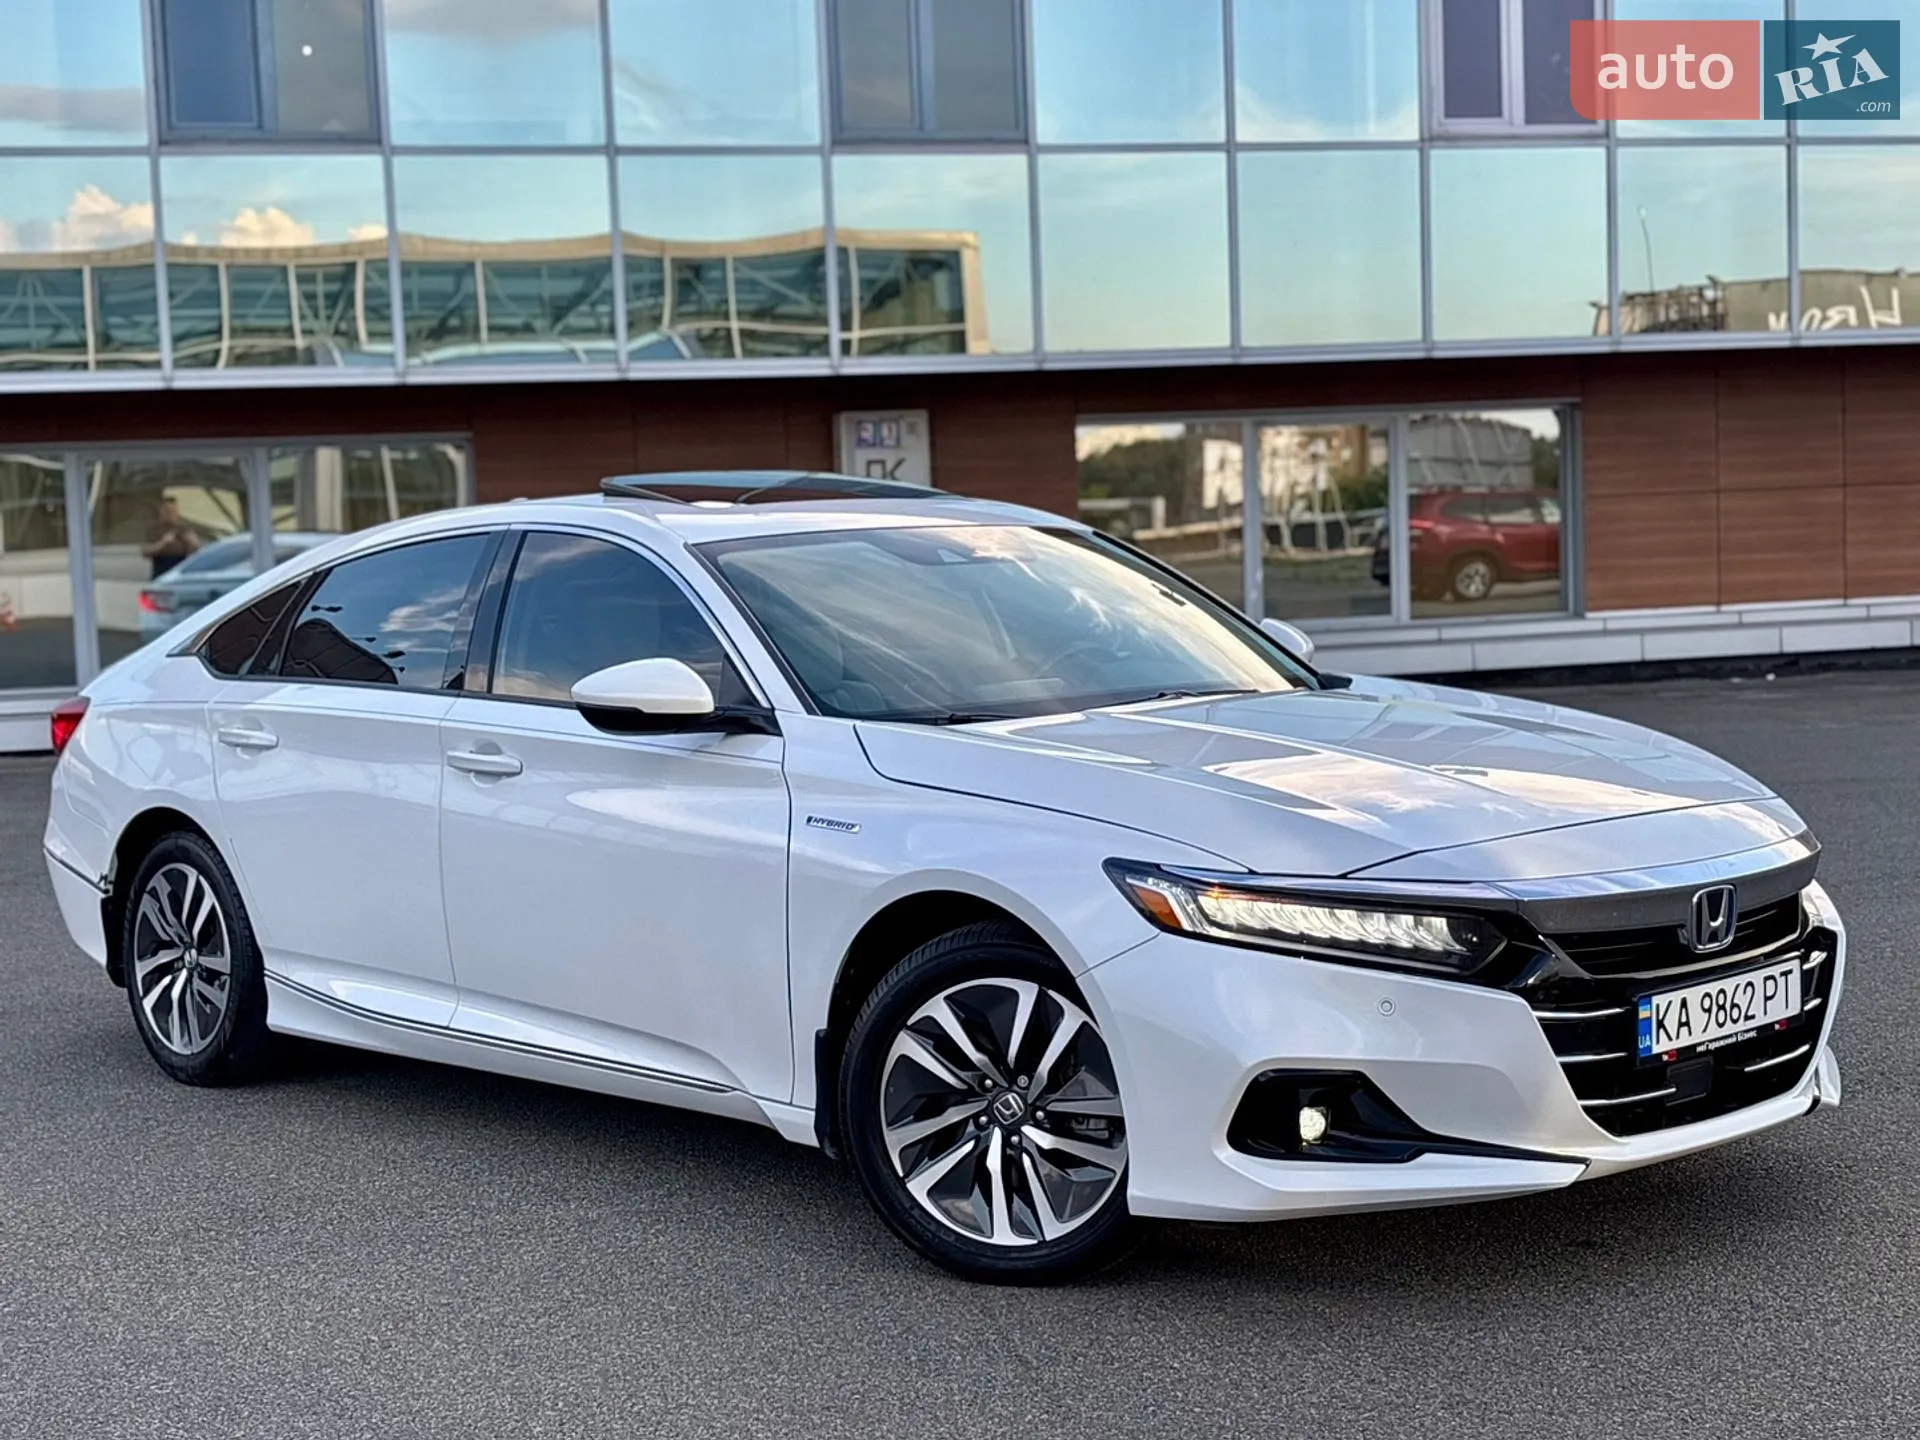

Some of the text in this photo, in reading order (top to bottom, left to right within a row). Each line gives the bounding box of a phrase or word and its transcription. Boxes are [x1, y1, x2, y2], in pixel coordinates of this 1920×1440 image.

[813, 816, 855, 831] HYBRID
[1655, 968, 1795, 1045] KA 9862 PT
[1638, 1034, 1651, 1049] UA
